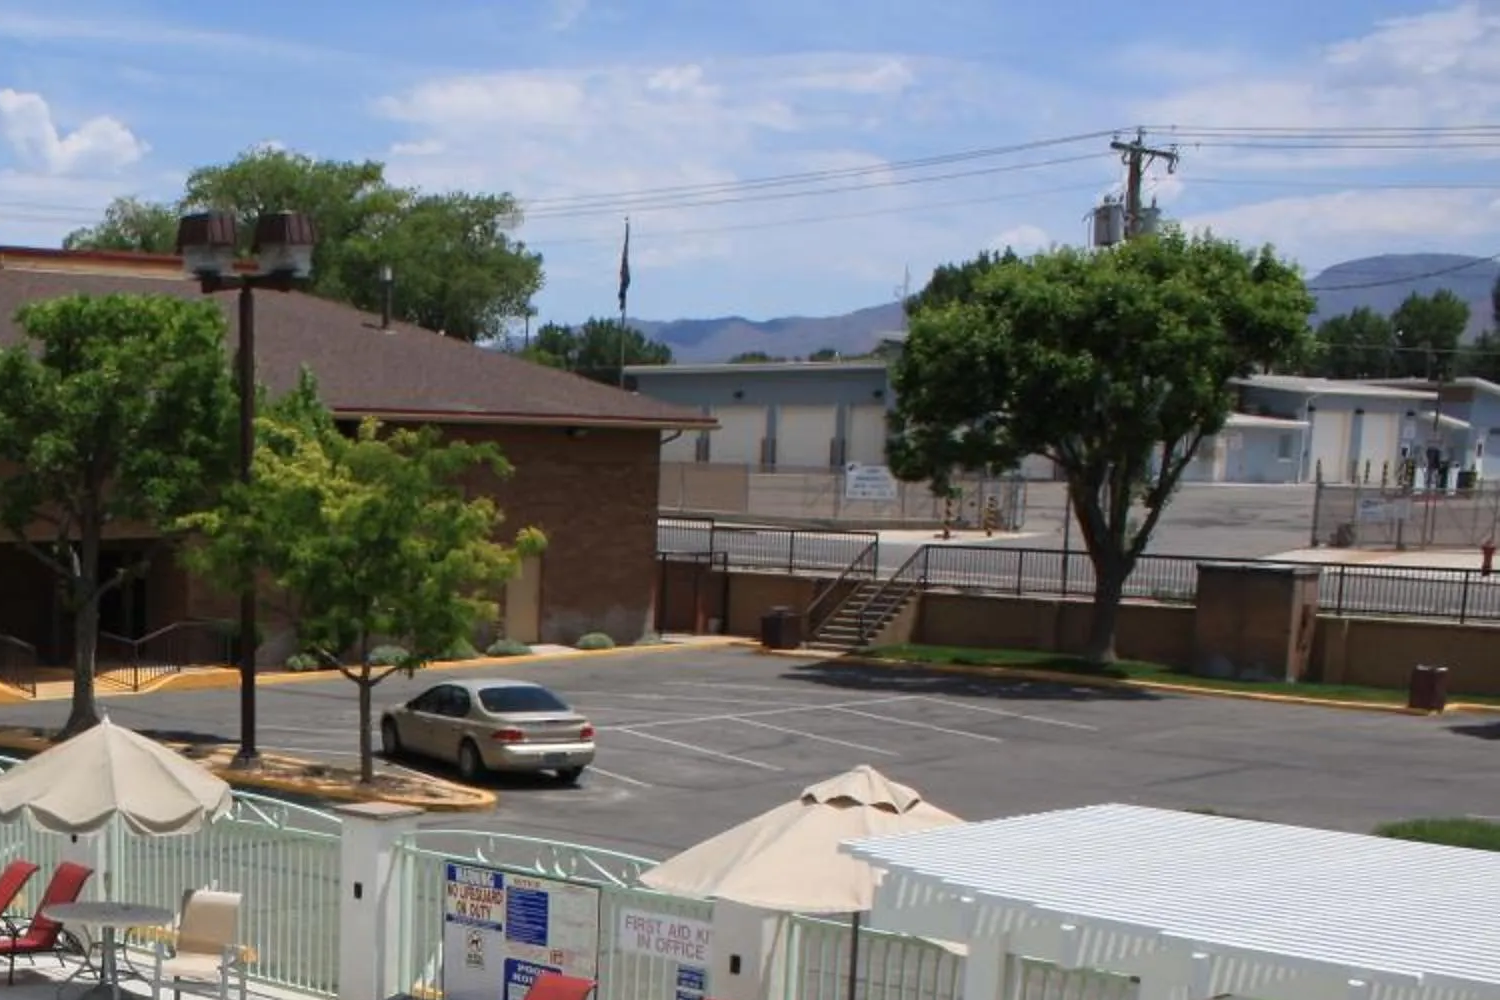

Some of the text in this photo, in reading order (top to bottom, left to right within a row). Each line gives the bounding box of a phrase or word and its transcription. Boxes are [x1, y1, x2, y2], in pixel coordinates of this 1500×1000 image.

[625, 914, 710, 945] FIRST AID KI
[636, 932, 705, 960] IN OFFICE
